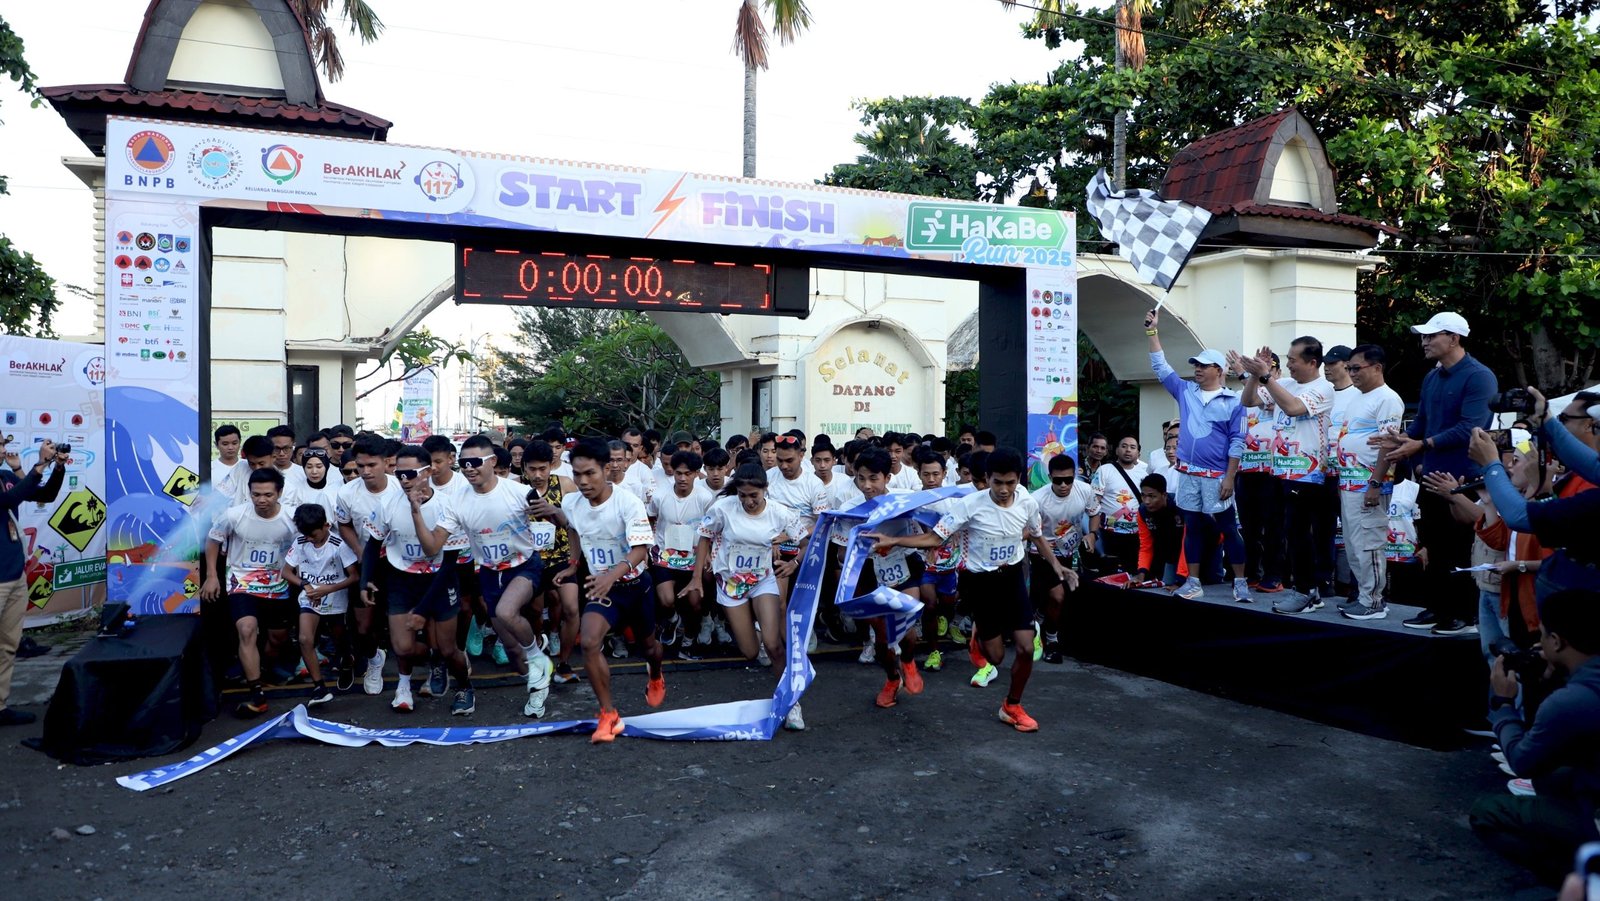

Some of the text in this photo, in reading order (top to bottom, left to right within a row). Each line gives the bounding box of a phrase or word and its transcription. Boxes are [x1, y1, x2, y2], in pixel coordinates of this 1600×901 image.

[323, 163, 401, 180] BerAKHLAK
[124, 174, 174, 188] BNPB
[424, 180, 452, 195] 117
[499, 171, 641, 216] START
[950, 214, 1053, 240] HaKaBe
[961, 236, 1072, 267] Run 2025
[127, 310, 142, 318] BNI
[10, 360, 62, 372] BerAKHLAK
[818, 346, 910, 384] Selamat
[89, 370, 105, 380] 117
[832, 384, 896, 396] DATANG
[854, 401, 870, 412] DI
[820, 423, 848, 435] TAMAN
[1062, 532, 1078, 551] 252
[250, 550, 275, 564] 061
[406, 544, 422, 557] 07
[482, 544, 509, 560] 078
[590, 548, 615, 564] 191
[990, 545, 1015, 562] 559
[736, 555, 760, 568] 041
[74, 564, 94, 575] JALUR
[878, 564, 904, 582] 233
